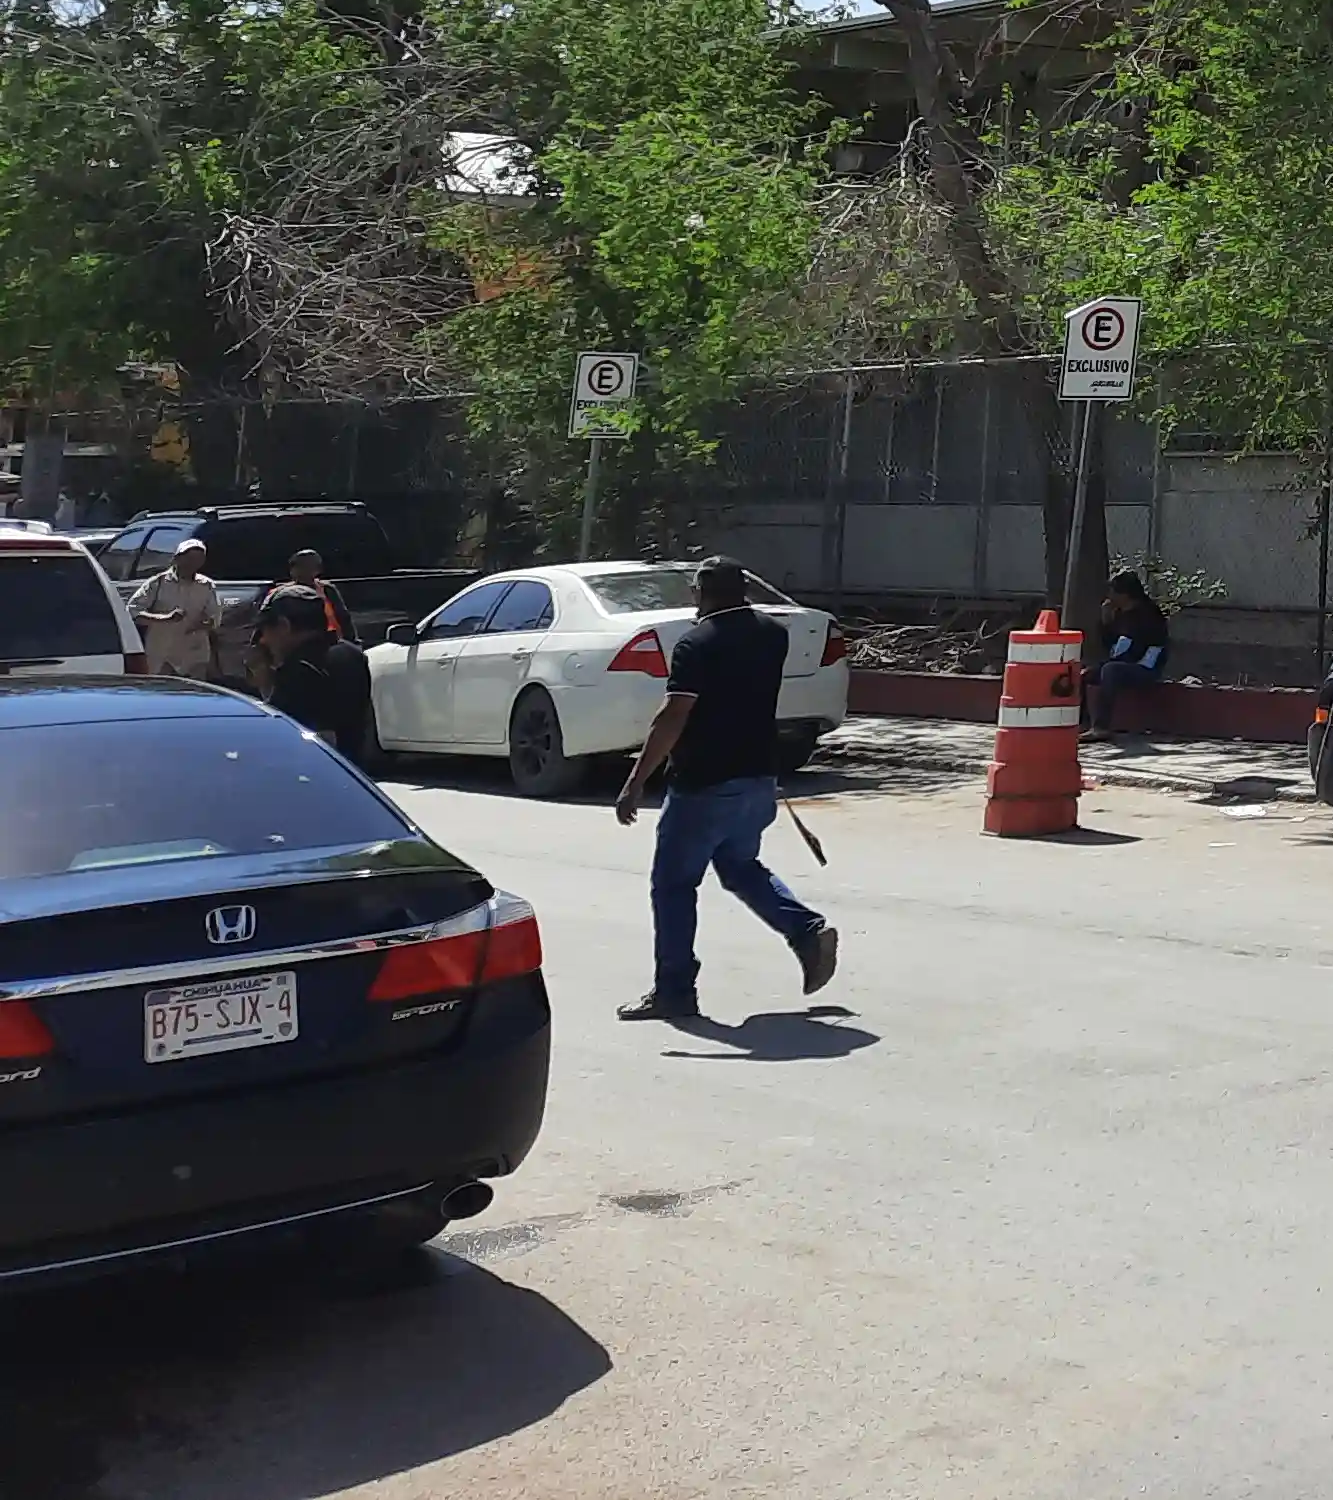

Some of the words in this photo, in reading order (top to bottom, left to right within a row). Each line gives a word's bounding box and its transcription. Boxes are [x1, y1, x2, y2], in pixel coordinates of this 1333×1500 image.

[1094, 315, 1113, 342] E
[1067, 359, 1130, 373] EXCLUSIVO
[597, 367, 614, 389] E
